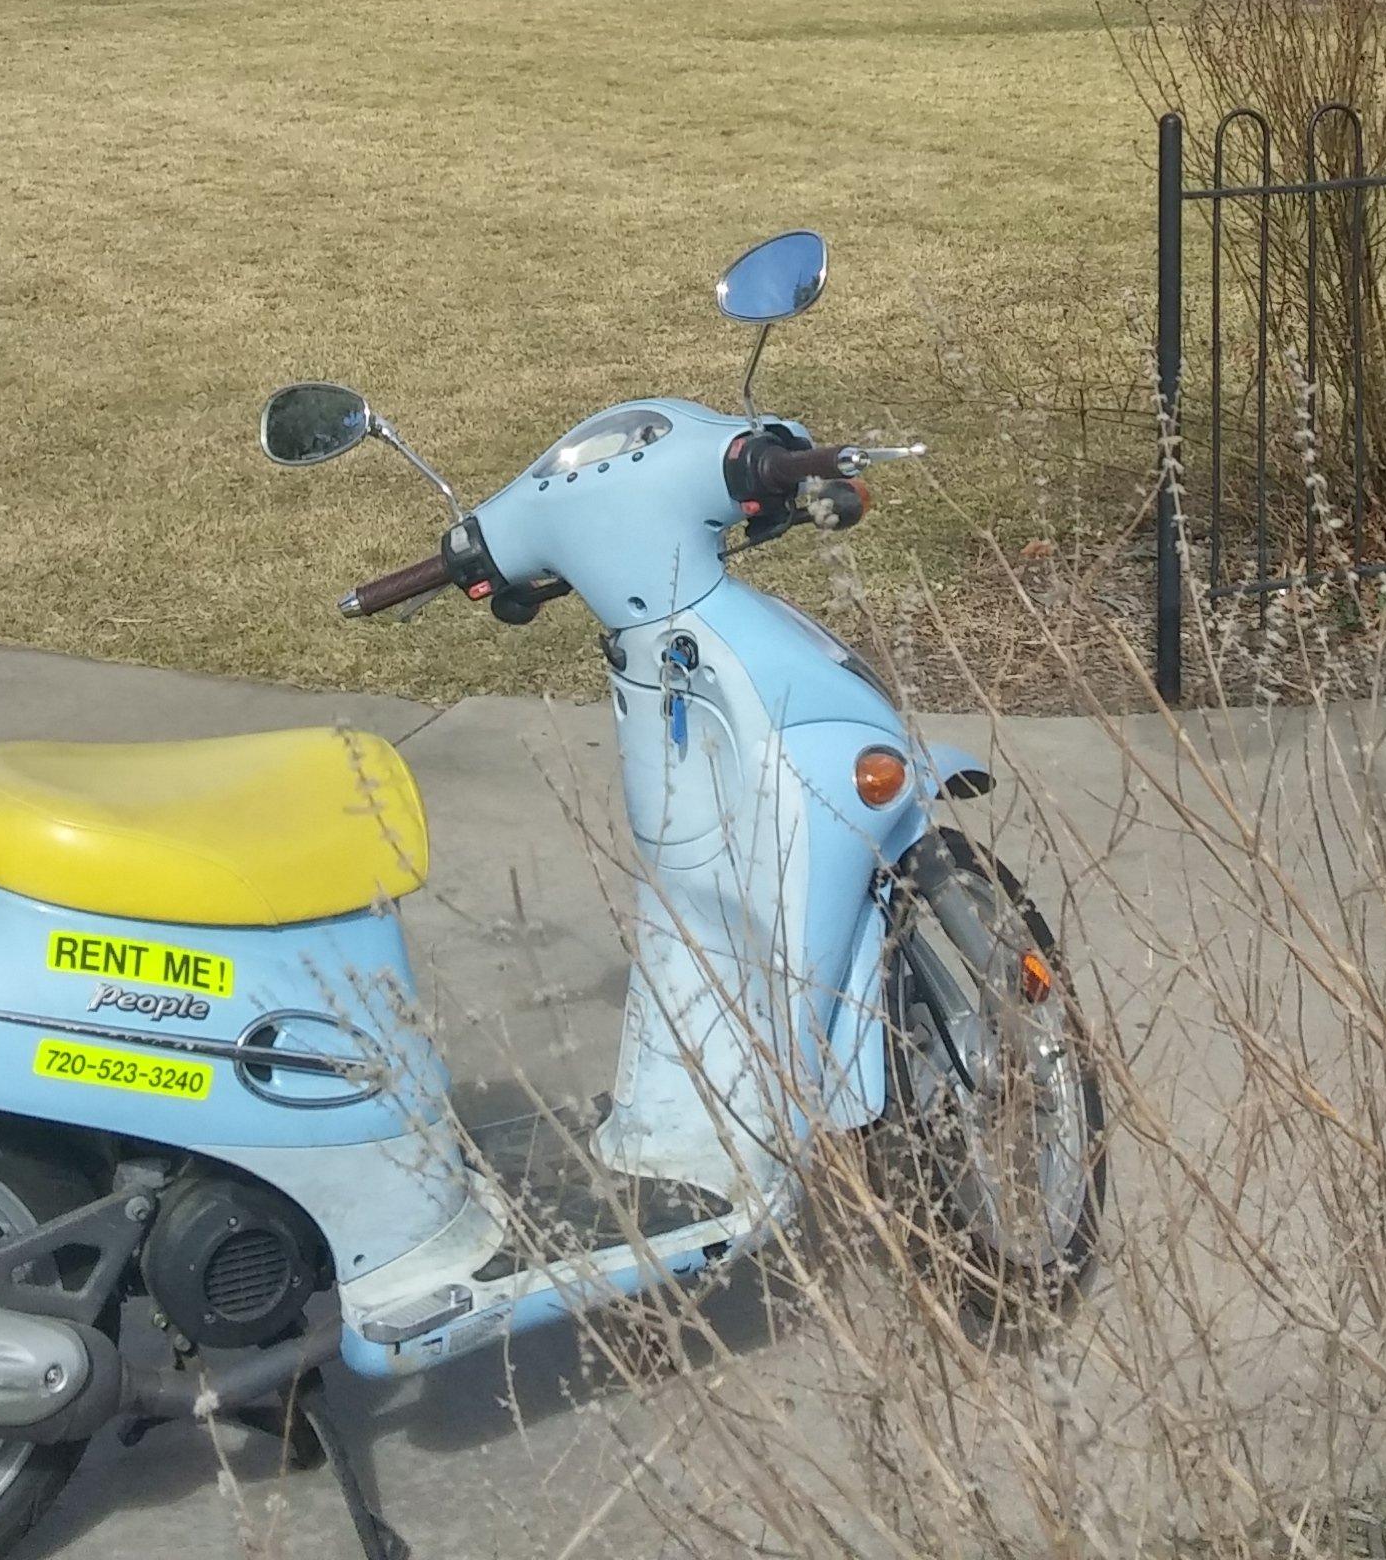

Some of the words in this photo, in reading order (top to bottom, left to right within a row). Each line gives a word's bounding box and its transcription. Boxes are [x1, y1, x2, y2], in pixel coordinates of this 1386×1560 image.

[53, 936, 149, 978] RENT
[162, 951, 226, 993] ME!
[86, 982, 211, 1022] People
[45, 1048, 205, 1094] 720-523-3240
